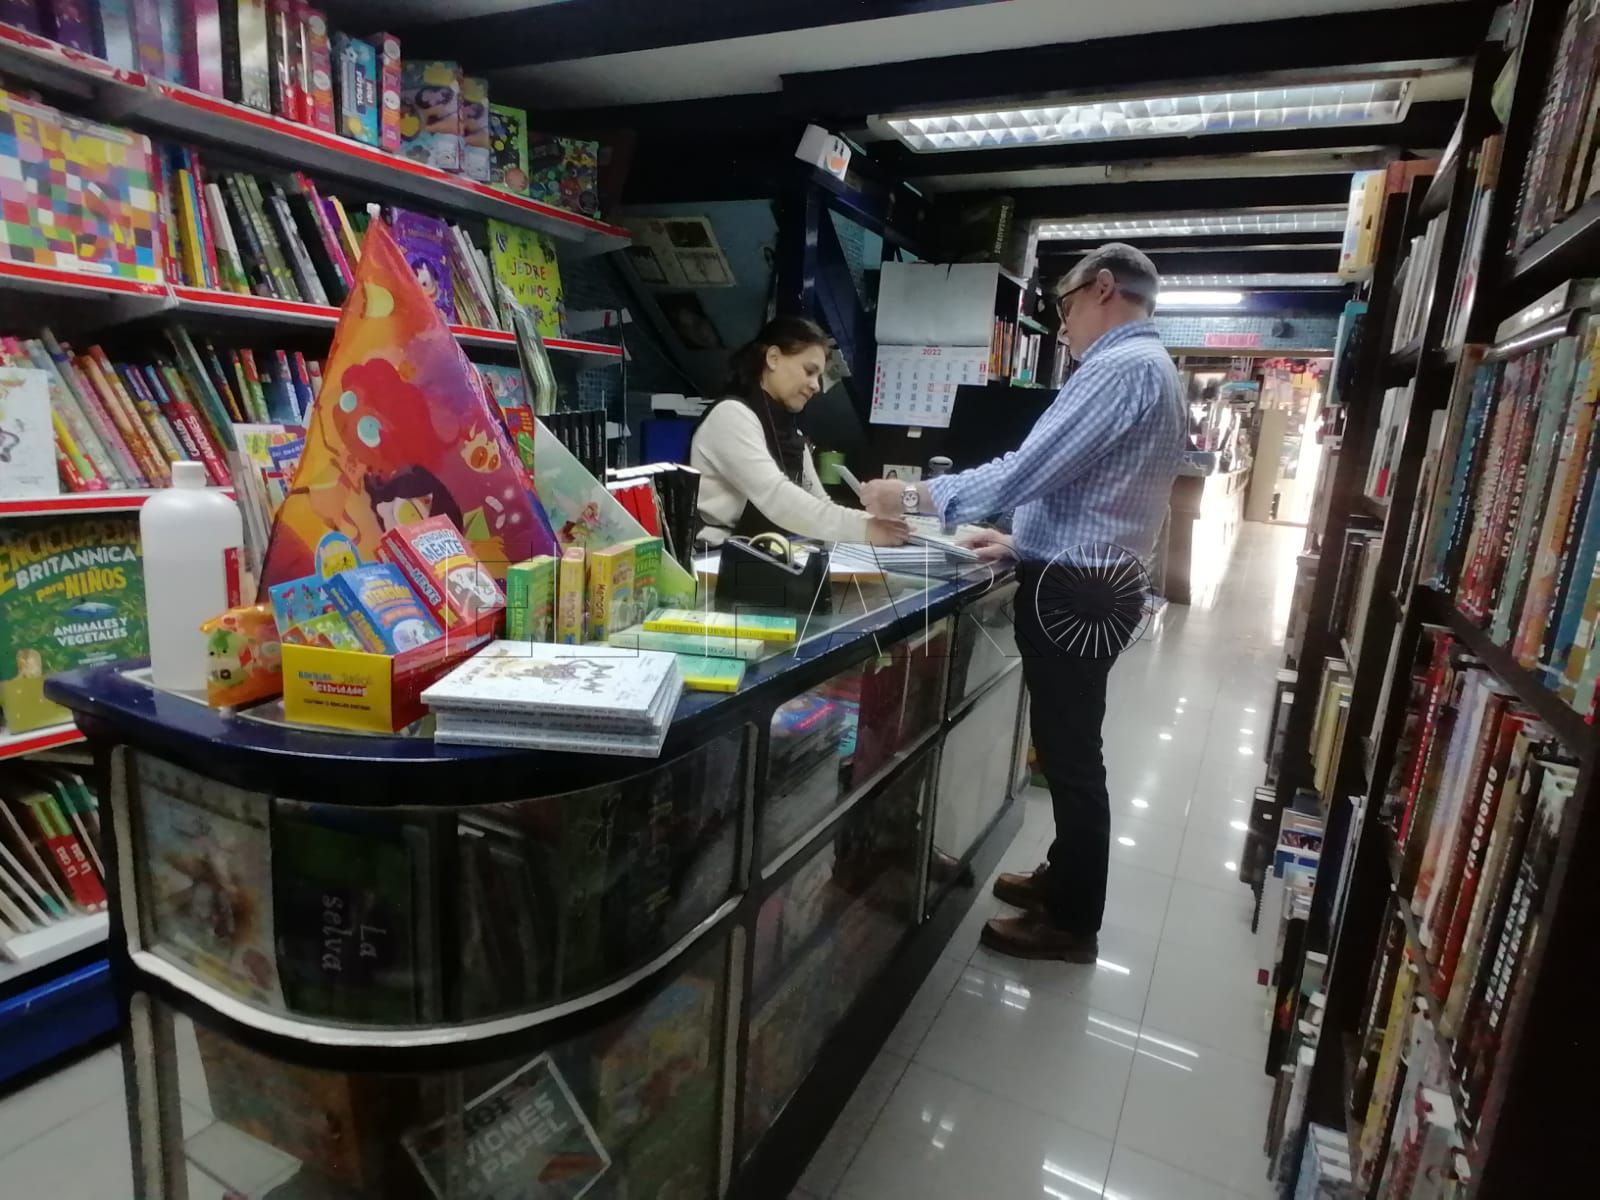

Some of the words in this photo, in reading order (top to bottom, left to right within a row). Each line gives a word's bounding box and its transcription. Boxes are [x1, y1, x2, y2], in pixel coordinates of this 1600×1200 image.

[922, 348, 942, 356] 2022
[0, 519, 143, 597] ENCICLOPEDI
[15, 545, 136, 591] BRITANNICA
[421, 539, 465, 563] MENTE
[63, 565, 127, 600] NIÑOS
[411, 567, 441, 605] MENTE
[53, 620, 119, 637] ANIMALES
[57, 627, 128, 647] VEGETALES
[321, 894, 353, 972] selva
[359, 924, 387, 959] La
[479, 1117, 568, 1176] PAPEL
